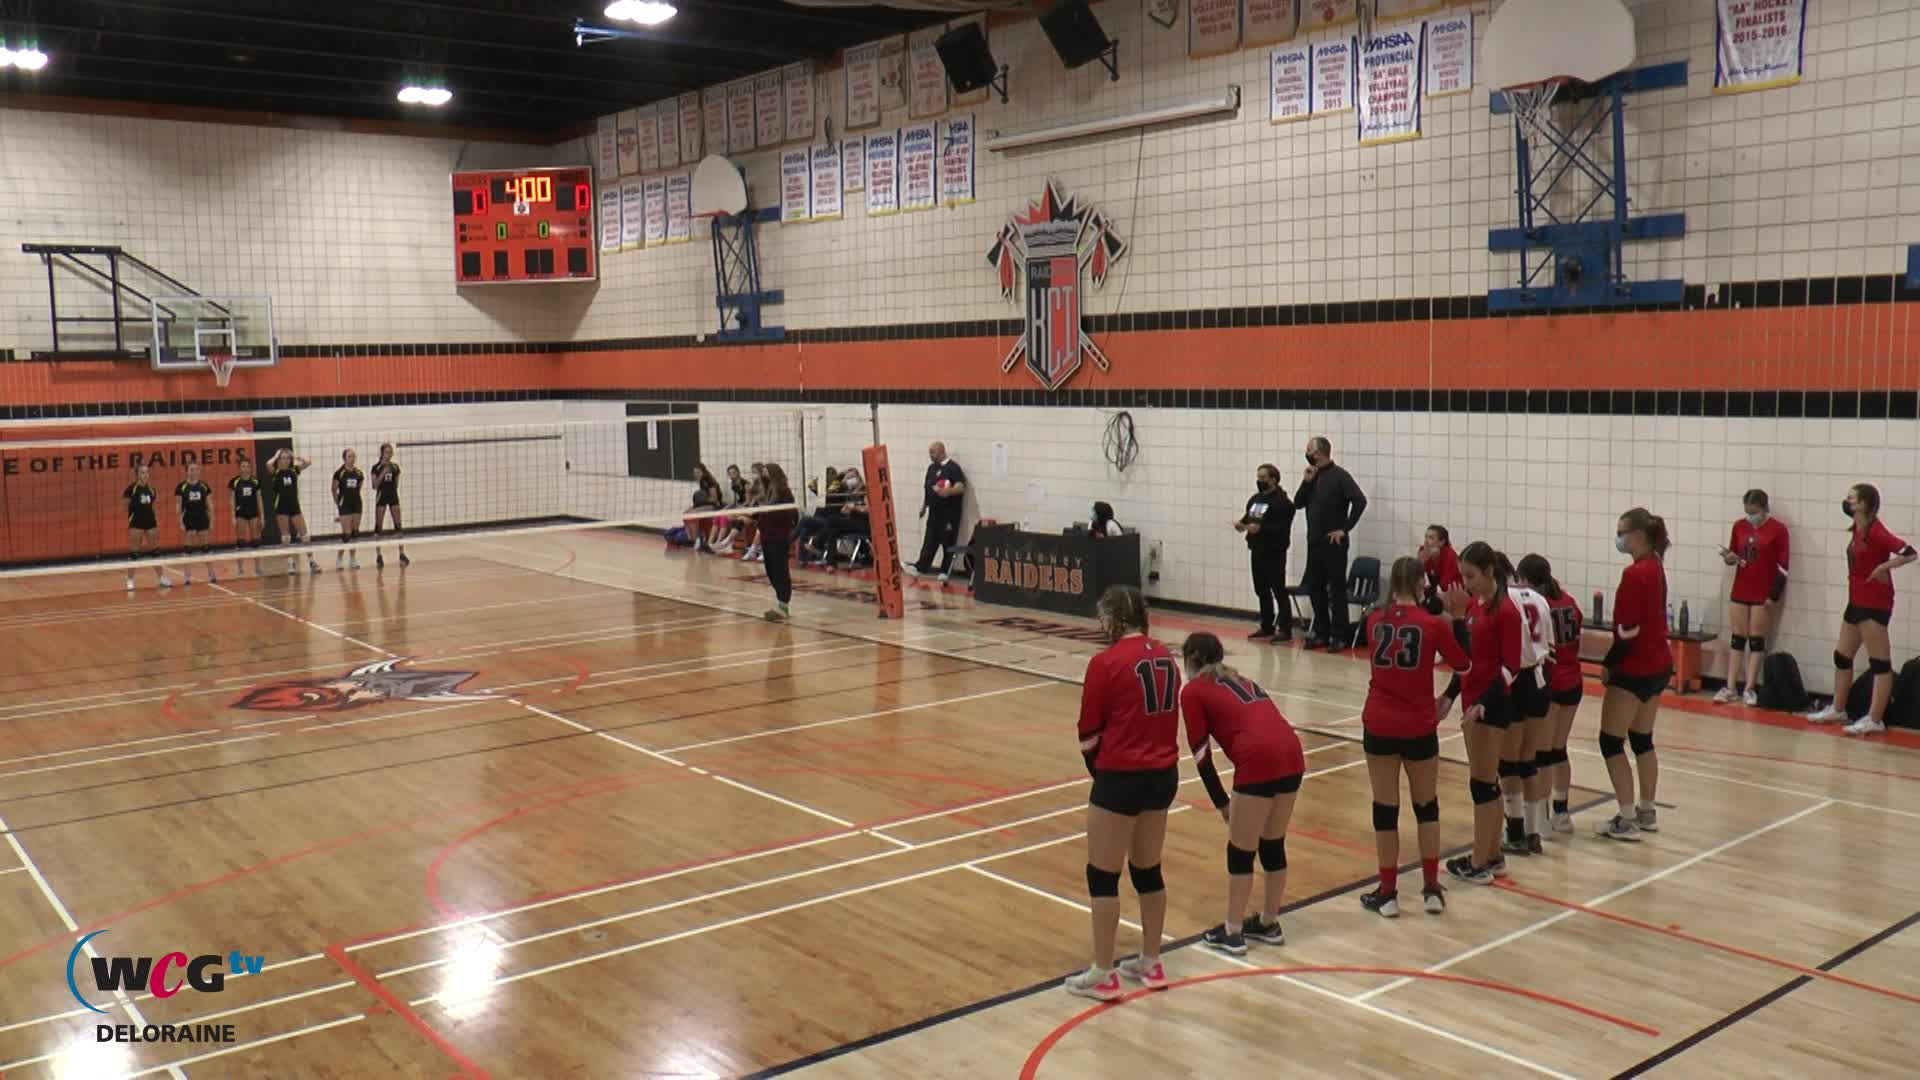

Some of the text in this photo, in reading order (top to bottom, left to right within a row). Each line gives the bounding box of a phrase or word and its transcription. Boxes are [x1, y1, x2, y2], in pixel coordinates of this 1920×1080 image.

[1432, 20, 1467, 34] MHSAA
[1735, 10, 1787, 29] FINALISTS
[1364, 31, 1415, 53] MHSAA
[1732, 25, 1788, 44] 2015-2016
[1364, 50, 1414, 68] PROVINCIAL
[29, 456, 65, 473] OF
[73, 453, 120, 470] THE
[129, 447, 248, 469] RAIDERS
[878, 467, 901, 592] RAIDERS
[983, 557, 1085, 595] RAIDERS
[1372, 622, 1423, 670] 23
[1135, 656, 1177, 716] 17
